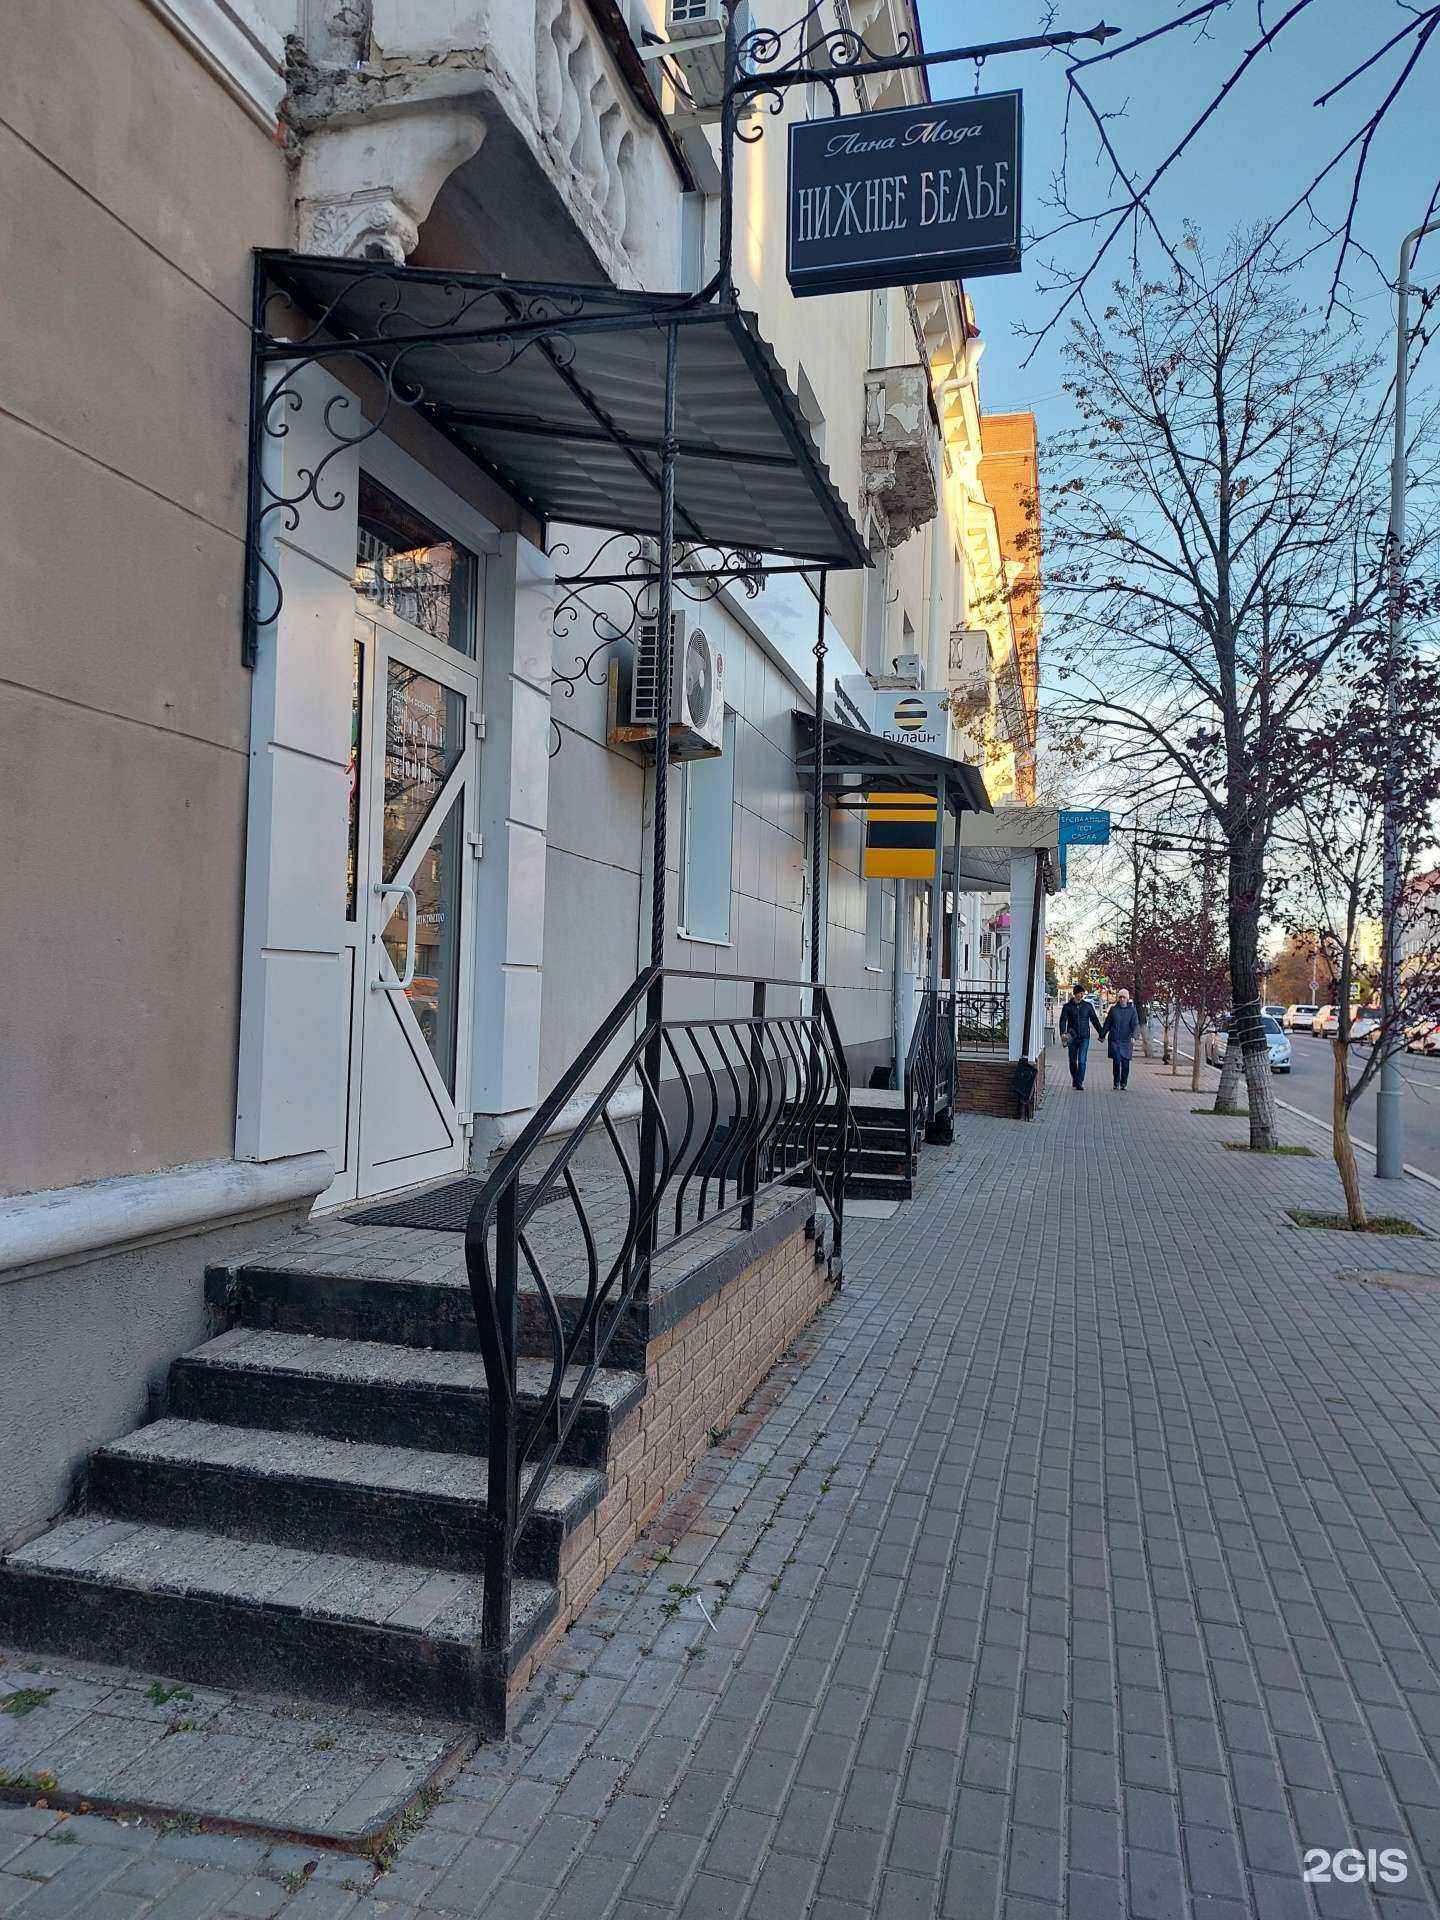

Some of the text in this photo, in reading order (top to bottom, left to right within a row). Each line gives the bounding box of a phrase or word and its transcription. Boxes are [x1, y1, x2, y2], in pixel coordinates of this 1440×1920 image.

[823, 119, 983, 158] Лана Мода
[798, 161, 1009, 242] НИЖНЕЕ БЕЛЬЕ
[882, 730, 936, 743] Билайн
